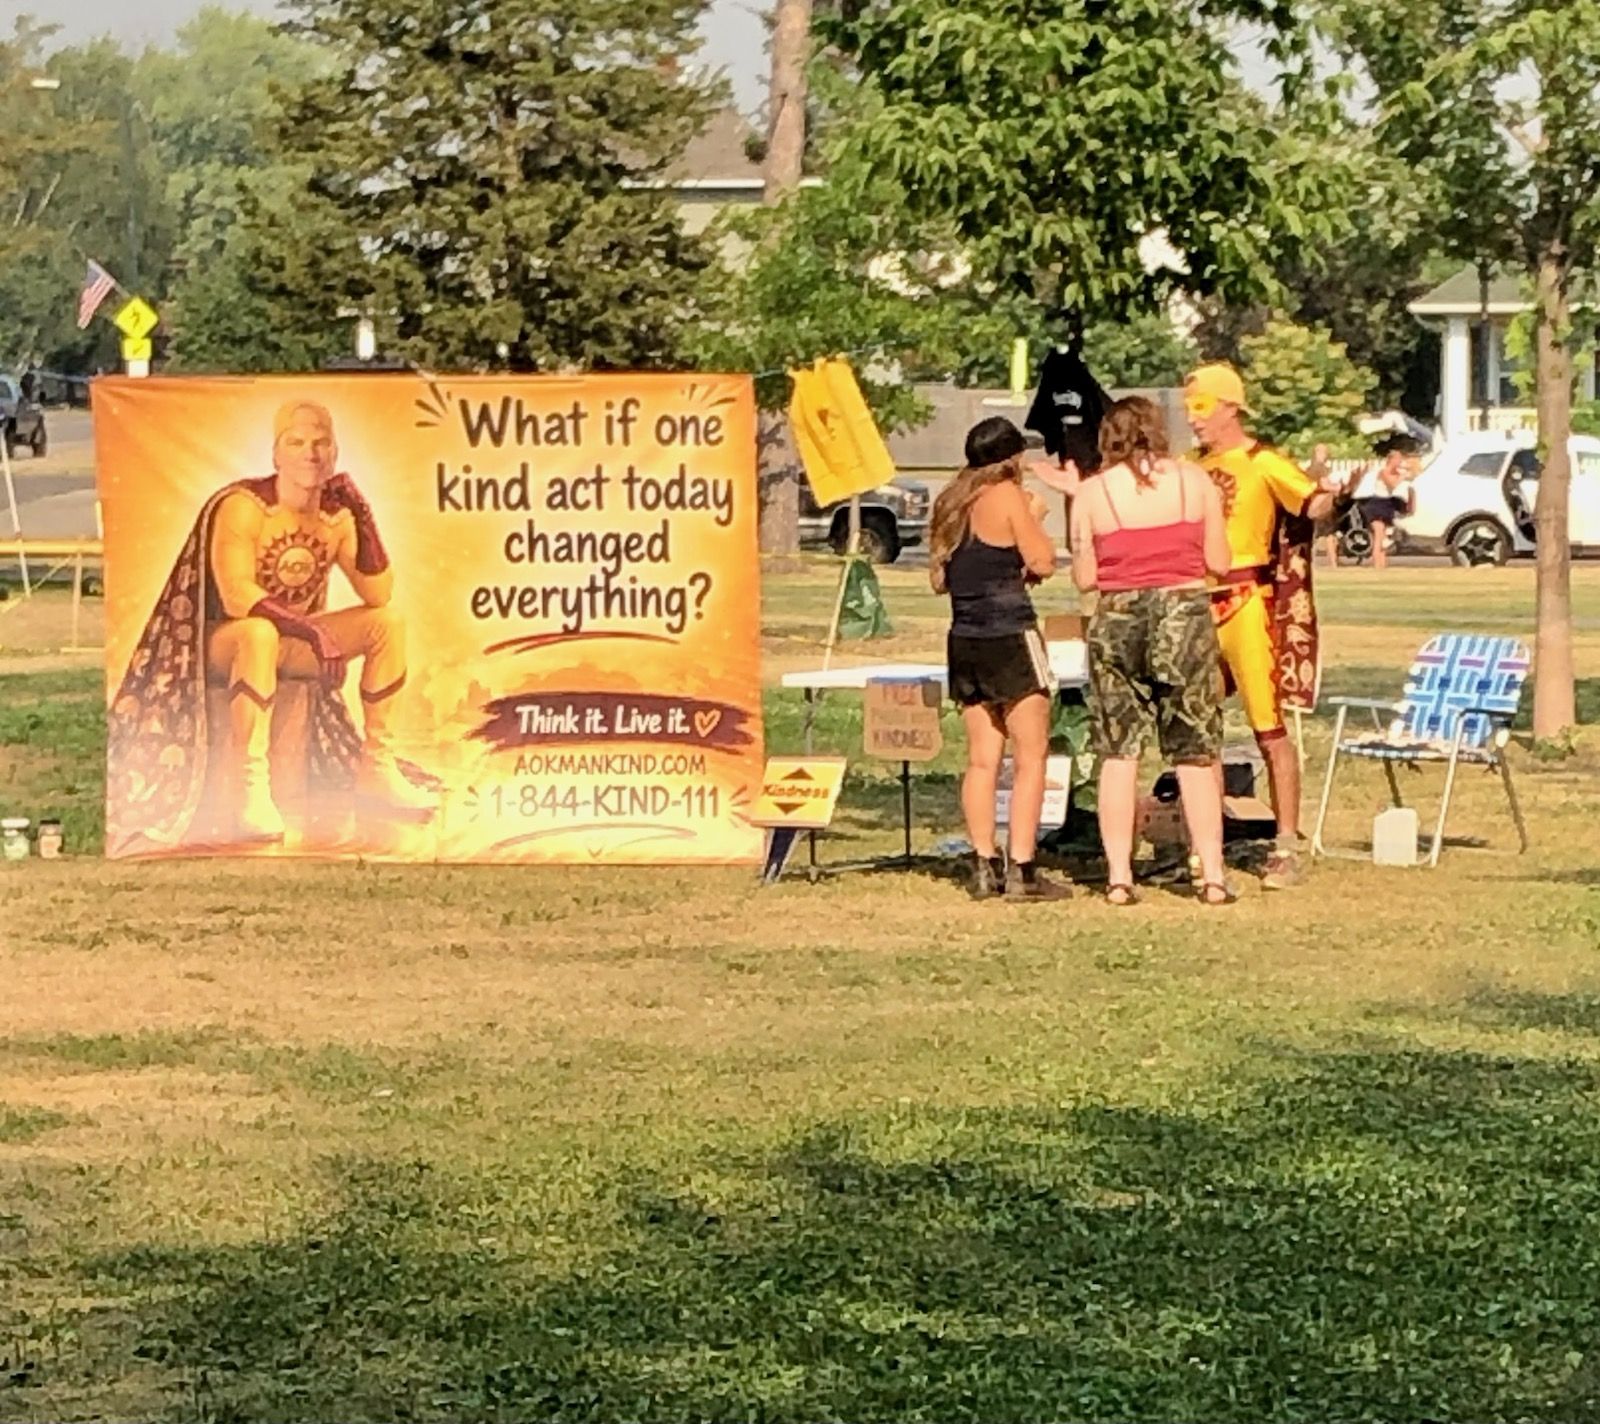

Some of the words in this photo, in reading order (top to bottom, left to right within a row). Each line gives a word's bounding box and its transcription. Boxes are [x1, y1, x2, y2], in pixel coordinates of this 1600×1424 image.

[459, 396, 588, 448] What
[605, 398, 640, 447] if
[655, 414, 724, 447] one
[437, 462, 531, 512] kind
[546, 464, 610, 511] act
[622, 464, 733, 526] today
[505, 519, 671, 578] changed
[471, 571, 712, 634] everything?
[515, 703, 579, 734] Think
[584, 706, 608, 734] it.
[614, 704, 662, 734] Live
[667, 707, 690, 734] it.
[514, 754, 706, 776] AOKMANKIND.COM
[490, 784, 720, 818] 1-844-KIND-111
[761, 784, 830, 799] Kindness
